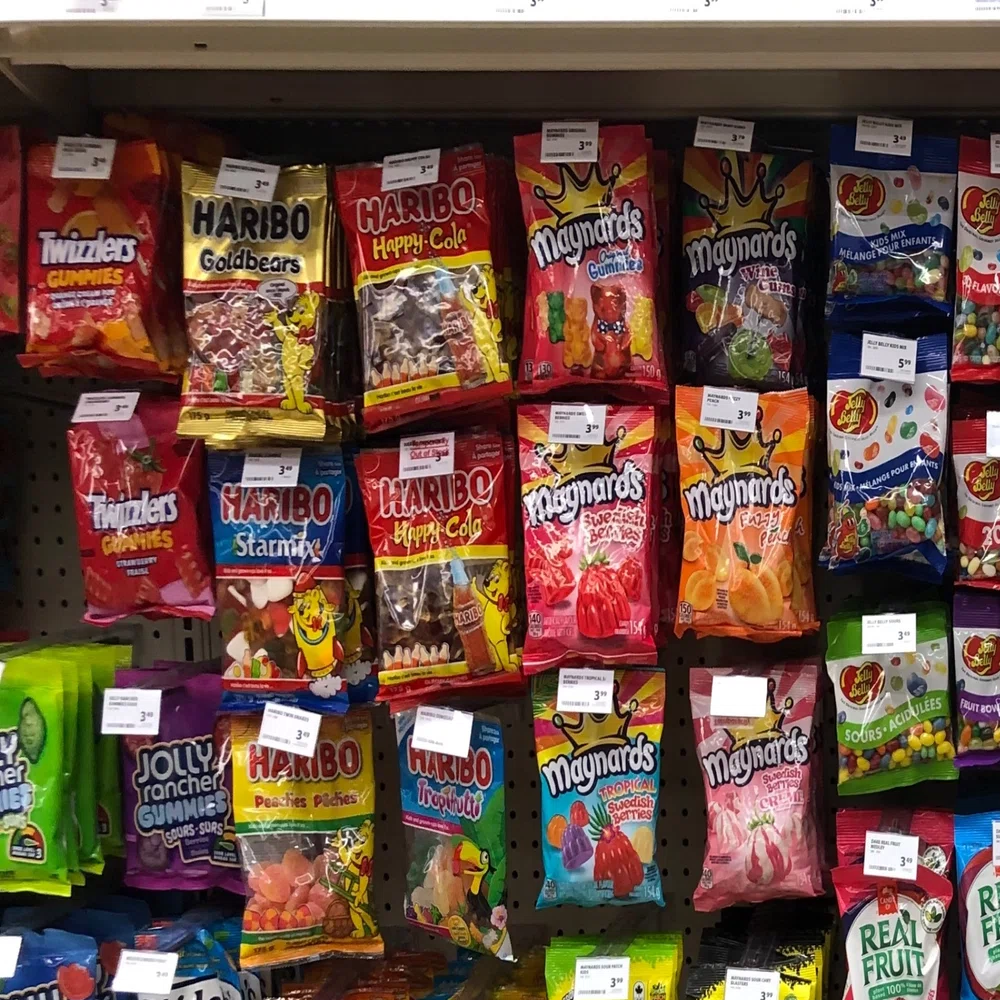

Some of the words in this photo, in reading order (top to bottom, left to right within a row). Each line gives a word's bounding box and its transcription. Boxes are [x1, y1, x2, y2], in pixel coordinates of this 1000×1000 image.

[193, 200, 310, 243] HARIBO
[357, 177, 475, 235] HARIBO
[38, 230, 136, 264] Twizzlers
[372, 232, 423, 260] Happy
[429, 221, 467, 250] Cola
[532, 199, 643, 270] Maynards
[686, 222, 797, 275] Maynards
[890, 230, 906, 241] MIX
[46, 269, 123, 287] GUMMIES
[200, 247, 301, 275] Goldbears
[740, 264, 778, 282] Wine
[88, 491, 178, 530] Twizzlers
[221, 483, 333, 525] HARIBO
[379, 468, 493, 518] HARIBO
[685, 471, 795, 523] Maynards
[739, 511, 779, 530] Fuzzy
[236, 533, 317, 559] Starmix
[845, 726, 882, 744] SOURS
[138, 743, 212, 784] JOLLY
[542, 735, 654, 798] Maynards
[704, 728, 808, 787] Maynards
[143, 774, 221, 801] rancher
[599, 778, 656, 801] TROPICAL
[762, 769, 801, 785] Swedish
[766, 781, 799, 794] Berries
[138, 791, 228, 829] GUMMIES
[607, 798, 654, 814] Swedish
[612, 809, 652, 824] Berries
[860, 917, 922, 956] REAL
[862, 950, 924, 986] FRUIT
